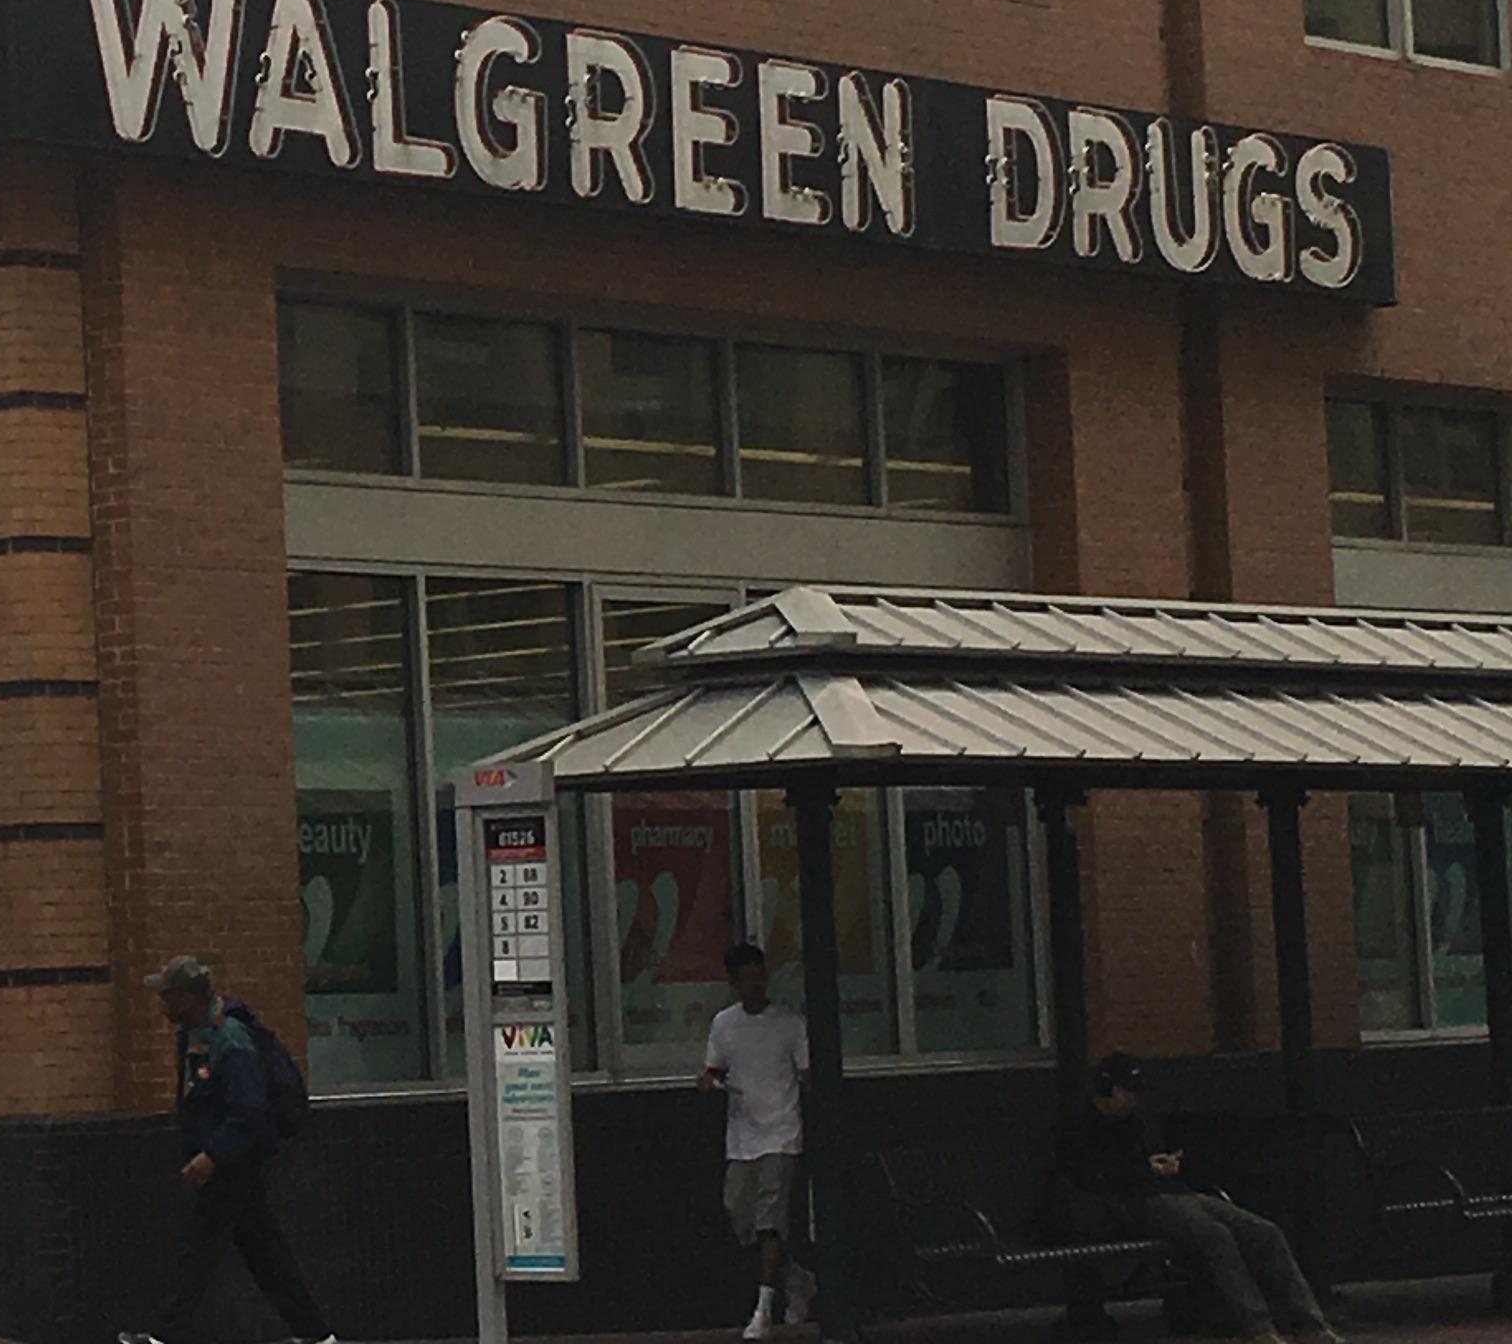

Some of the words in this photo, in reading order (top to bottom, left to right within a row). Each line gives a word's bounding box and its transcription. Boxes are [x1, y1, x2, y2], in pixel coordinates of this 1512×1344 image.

[985, 93, 1364, 289] DRUGS
[473, 767, 506, 788] VIA
[298, 816, 373, 864] eauty
[630, 819, 714, 855] pharmacy
[923, 812, 986, 857] photo
[499, 868, 507, 885] 2
[499, 893, 508, 907] 4
[501, 1024, 554, 1049] VIVA
